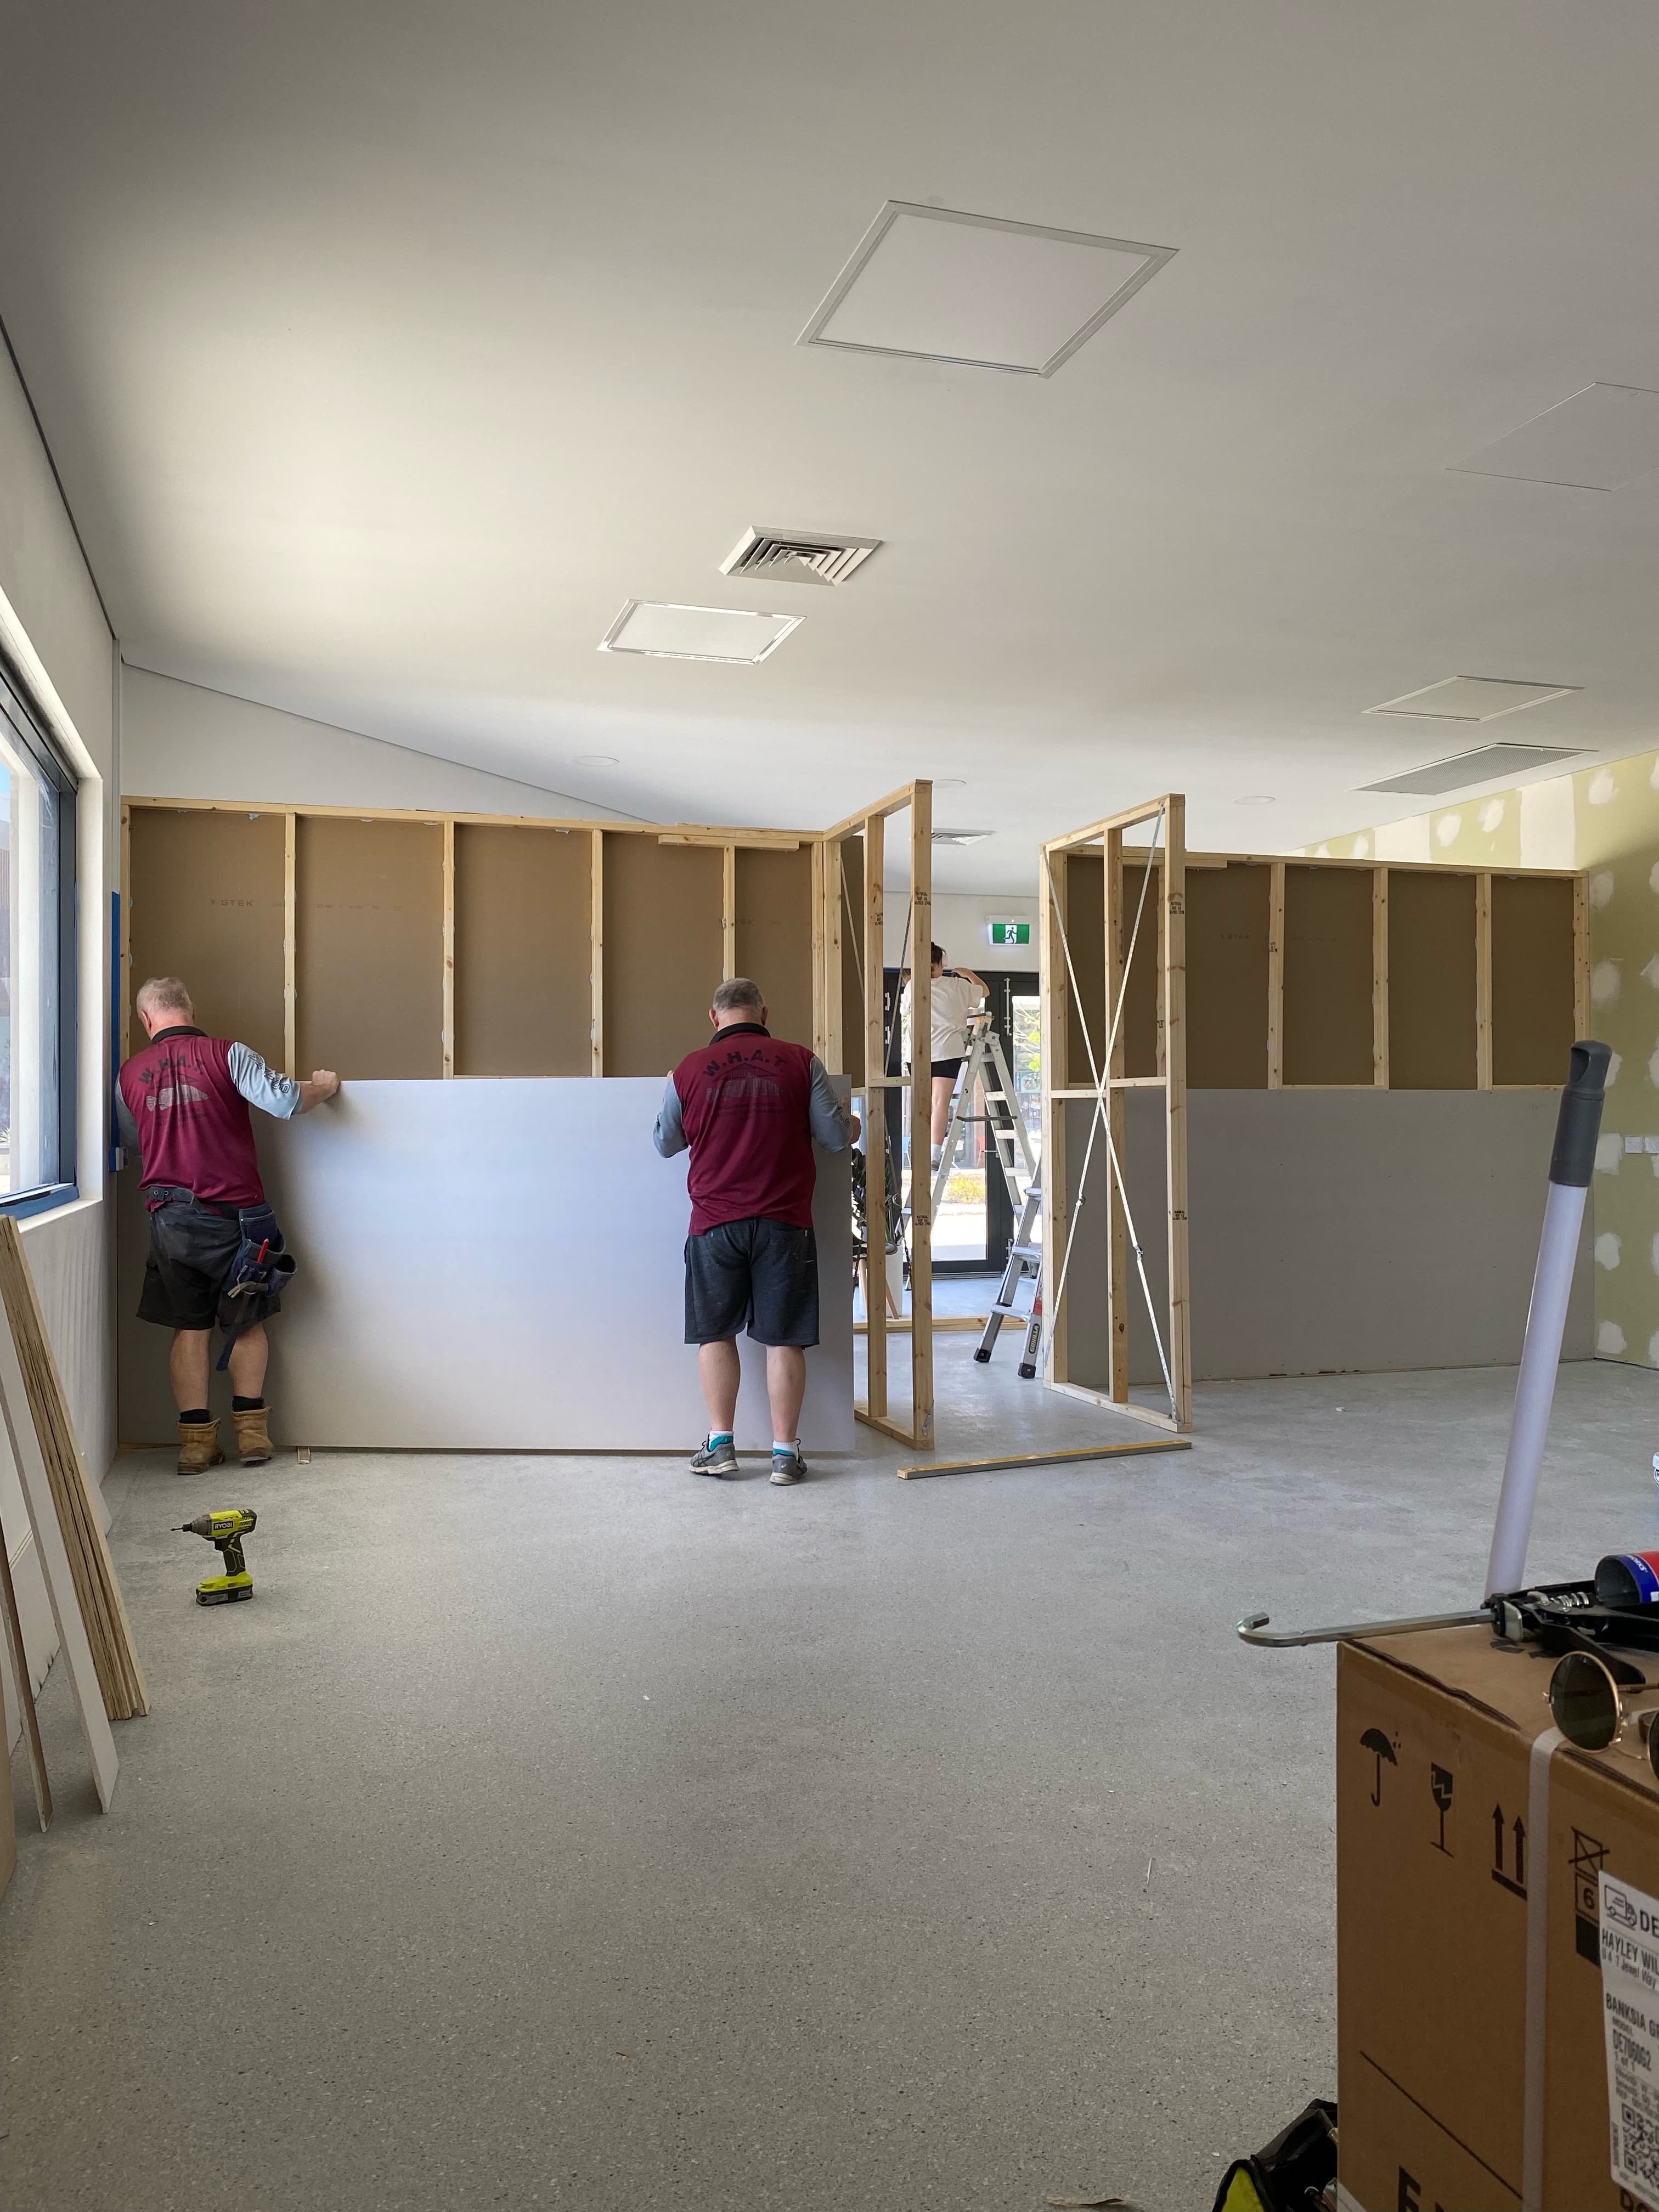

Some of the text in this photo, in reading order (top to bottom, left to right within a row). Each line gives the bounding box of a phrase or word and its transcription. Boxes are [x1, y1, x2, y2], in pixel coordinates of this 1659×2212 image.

[1029, 1325, 1040, 1353] GORILLA
[1583, 1888, 1595, 1910] 6
[1602, 1928, 1638, 1962] HAYLEY
[1606, 1993, 1646, 2032] BANKSIA
